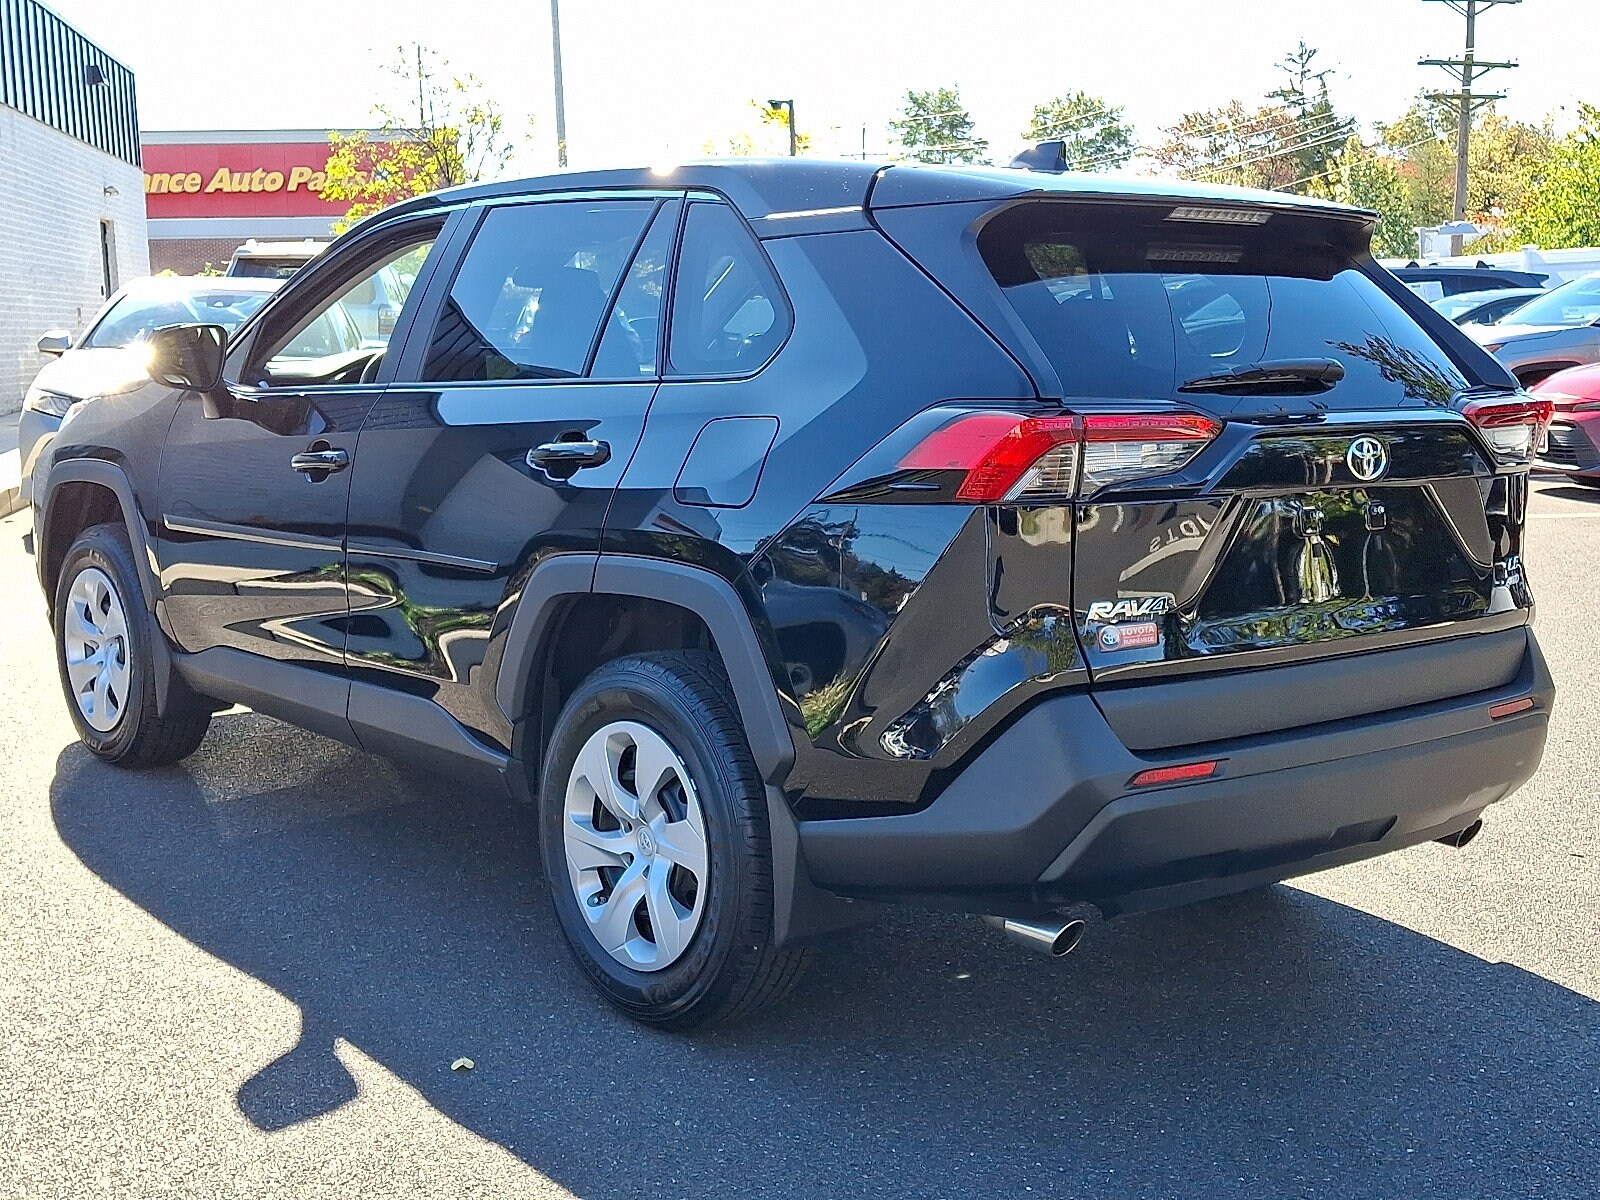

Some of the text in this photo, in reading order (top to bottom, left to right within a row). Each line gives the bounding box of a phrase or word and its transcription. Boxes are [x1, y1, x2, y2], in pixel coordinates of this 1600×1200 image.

[204, 167, 284, 194] Auto
[1087, 597, 1169, 621] RAV4
[1120, 626, 1155, 636] TOYOTA
